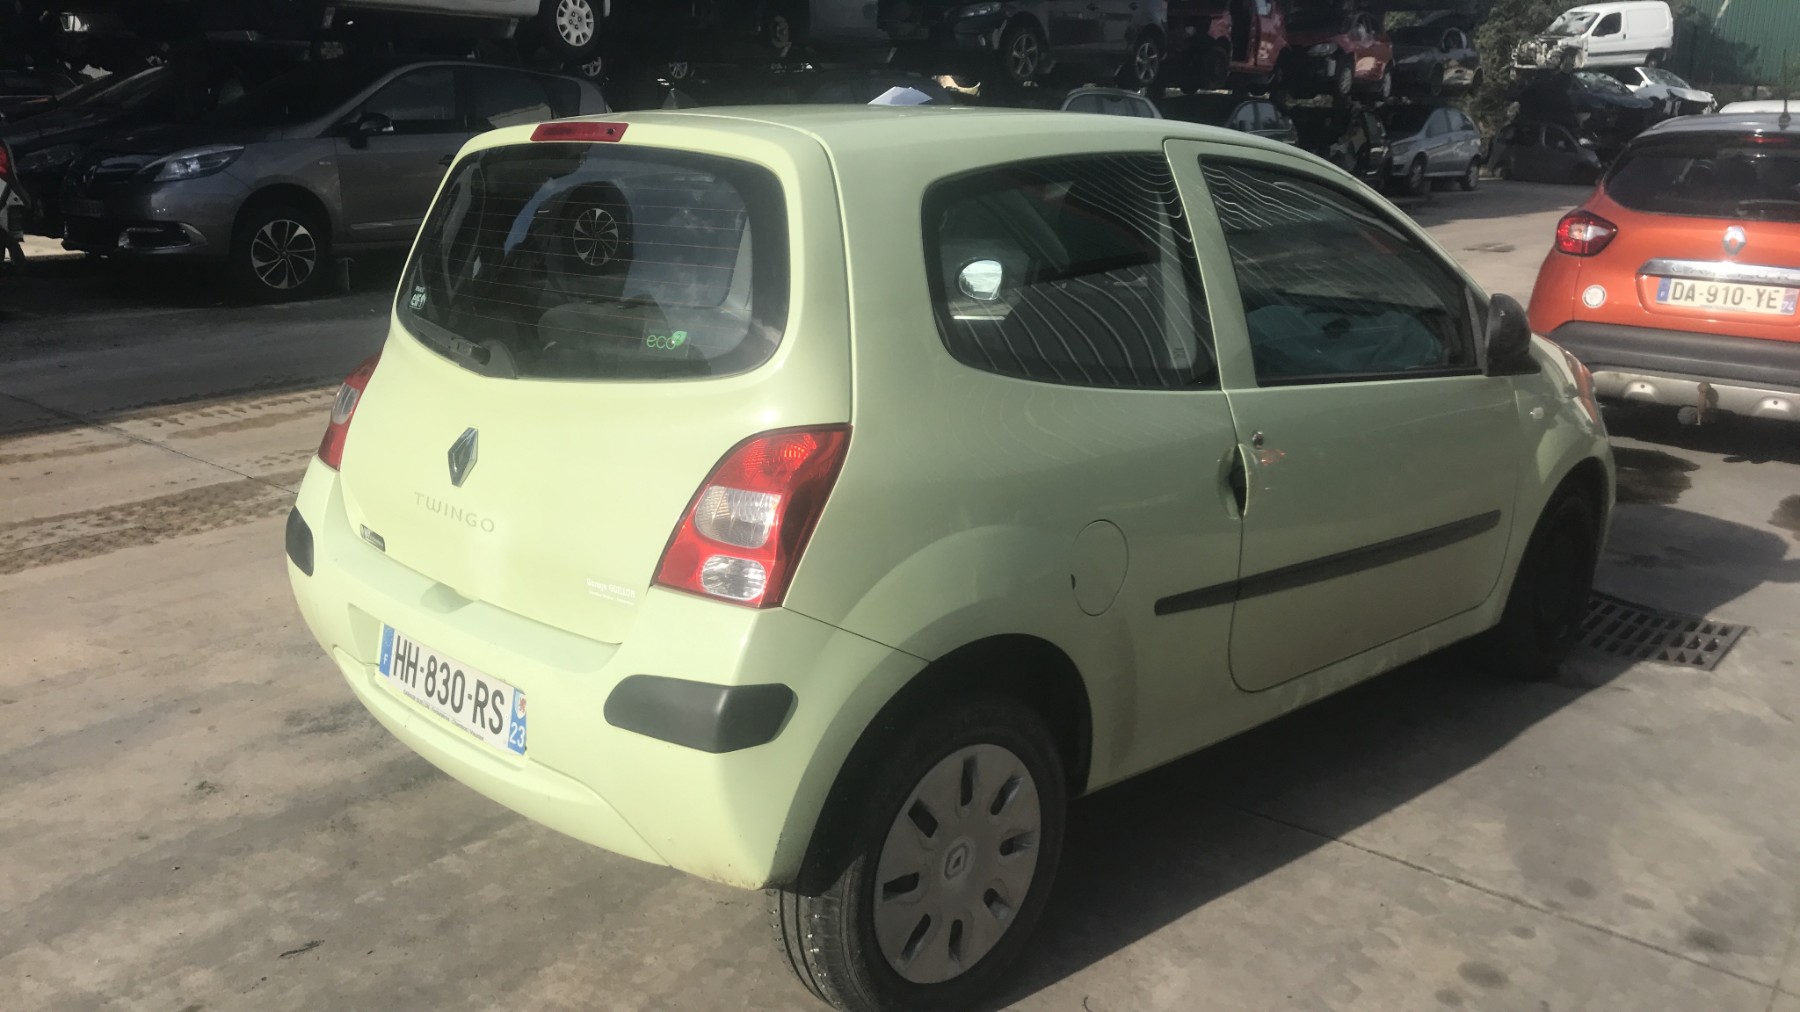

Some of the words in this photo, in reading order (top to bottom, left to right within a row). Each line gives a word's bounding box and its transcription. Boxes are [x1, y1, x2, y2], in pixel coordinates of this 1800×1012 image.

[1671, 281, 1780, 309] DA-910-YE
[414, 491, 495, 533] TWINGO
[382, 653, 389, 665] F
[393, 634, 505, 735] HH-830-RS
[509, 721, 526, 748] 23
